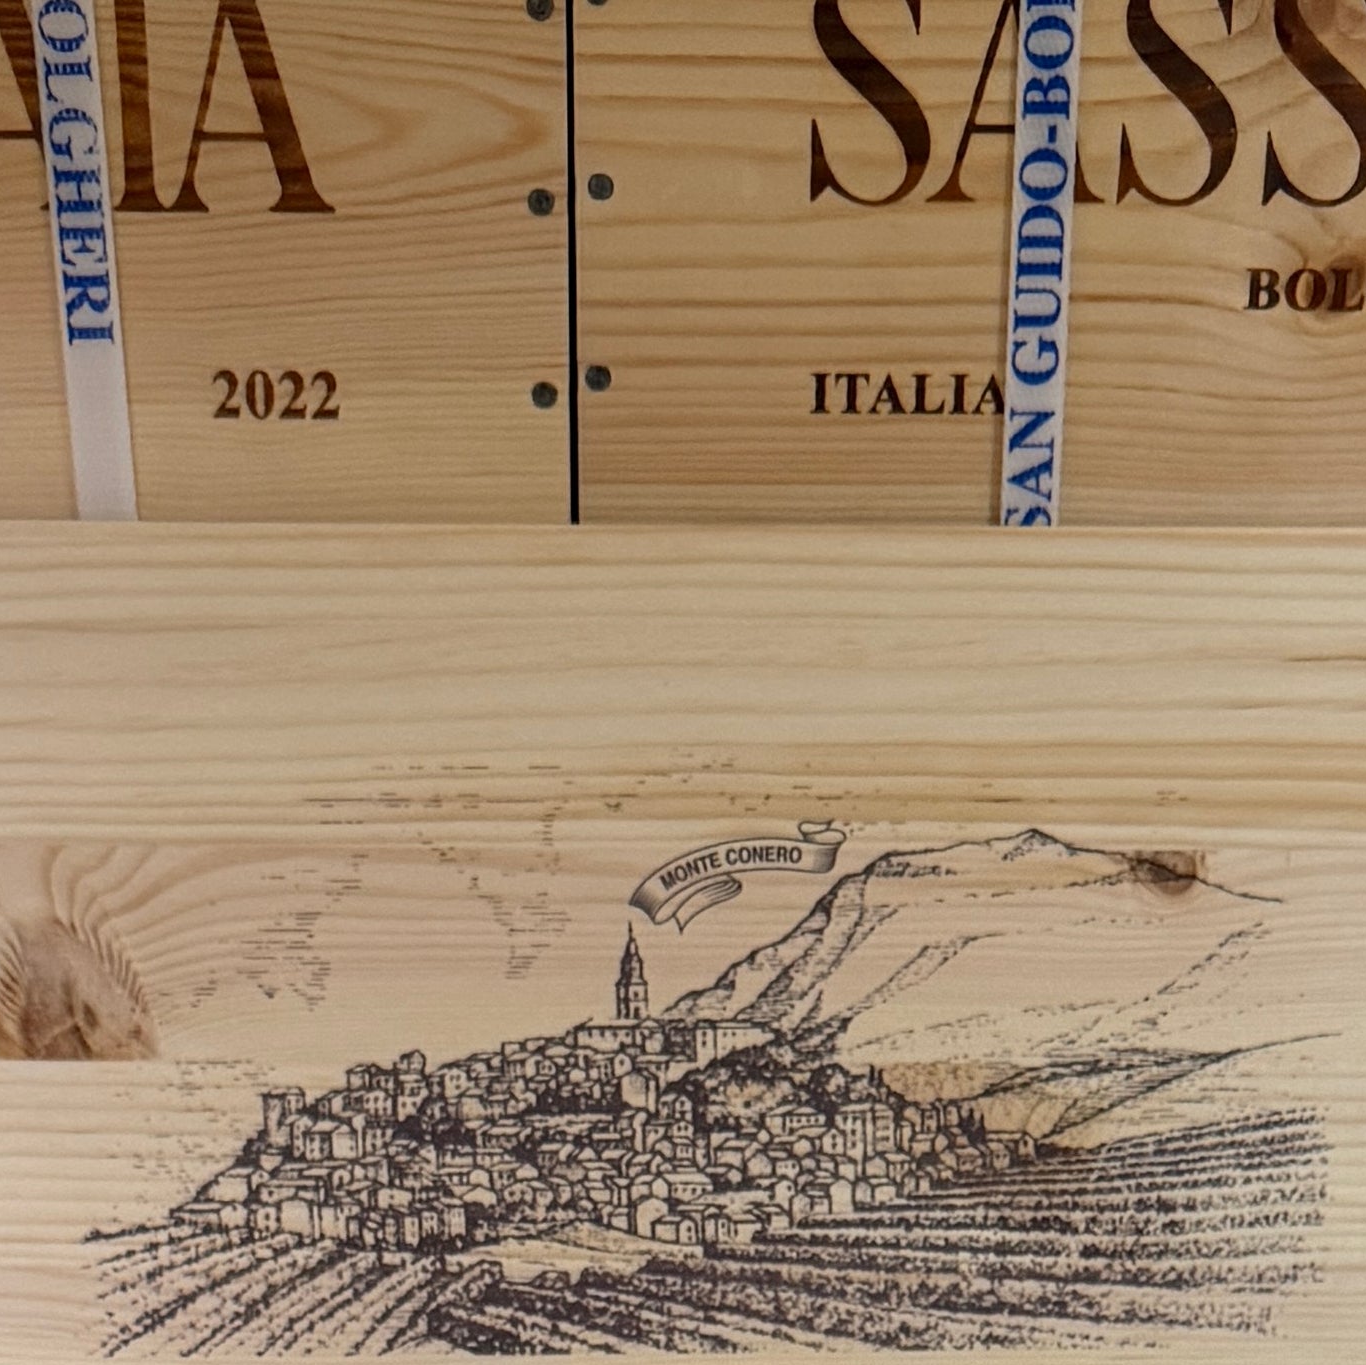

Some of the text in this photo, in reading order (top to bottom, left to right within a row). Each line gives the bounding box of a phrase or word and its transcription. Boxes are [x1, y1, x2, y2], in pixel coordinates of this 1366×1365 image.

[212, 369, 340, 422] 2022
[809, 372, 1006, 415] ITALIA
[659, 845, 803, 892] MONTE CONERO
